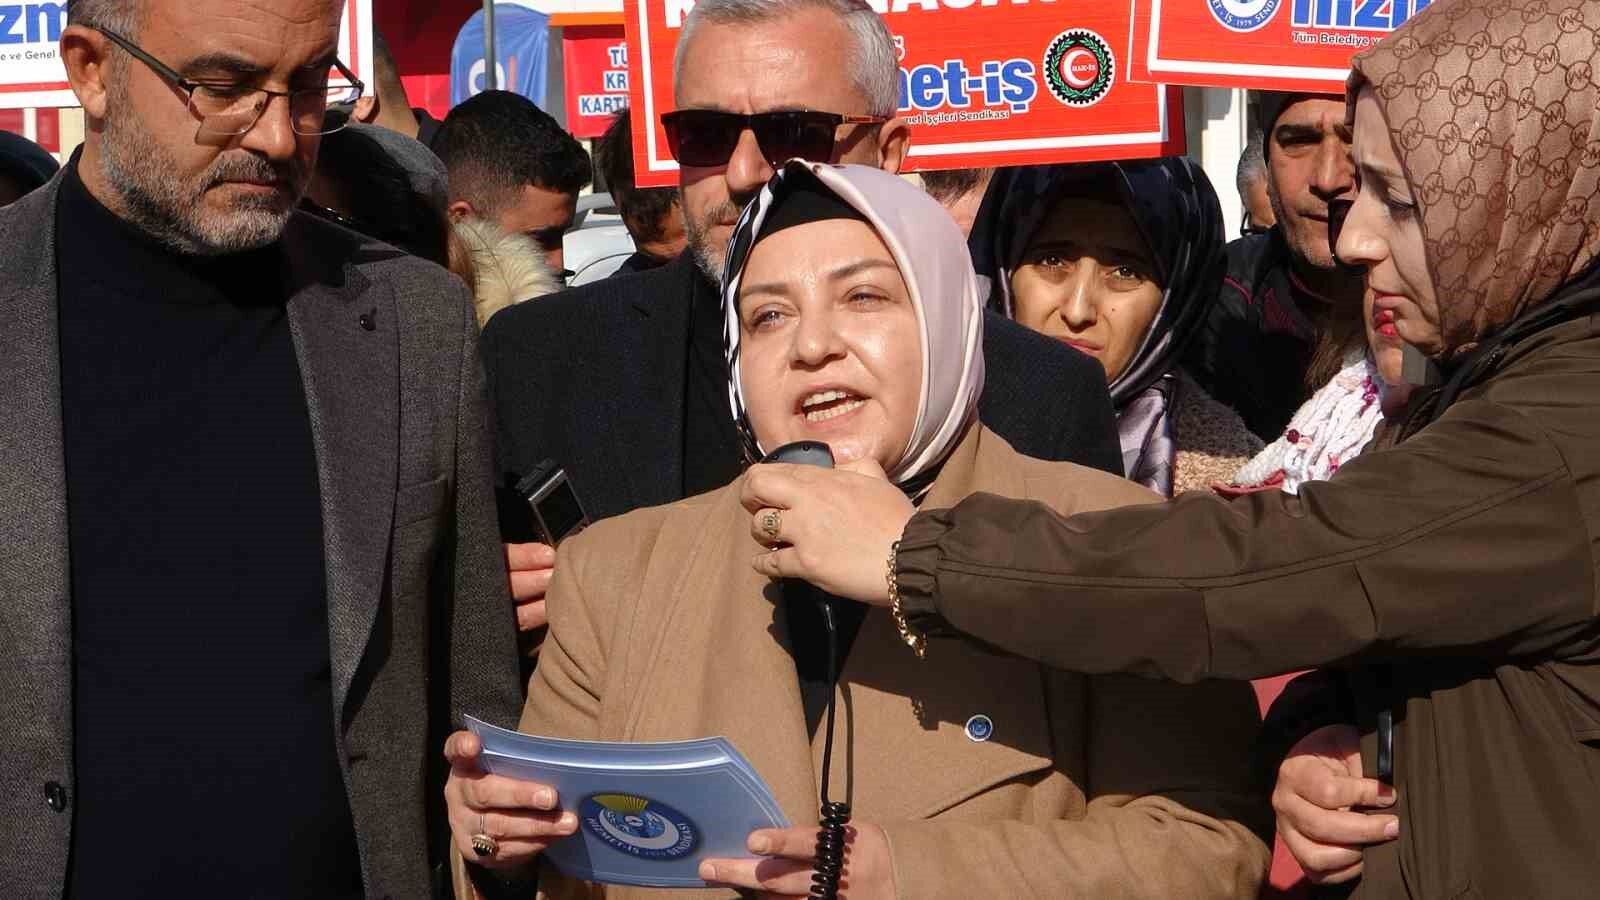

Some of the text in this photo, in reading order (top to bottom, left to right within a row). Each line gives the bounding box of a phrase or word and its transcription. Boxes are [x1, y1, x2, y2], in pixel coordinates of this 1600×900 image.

[1293, 32, 1317, 43] Tüm
[1320, 34, 1369, 46] Belediye
[25, 50, 56, 60] Genel
[960, 109, 1009, 121] Sendikası
